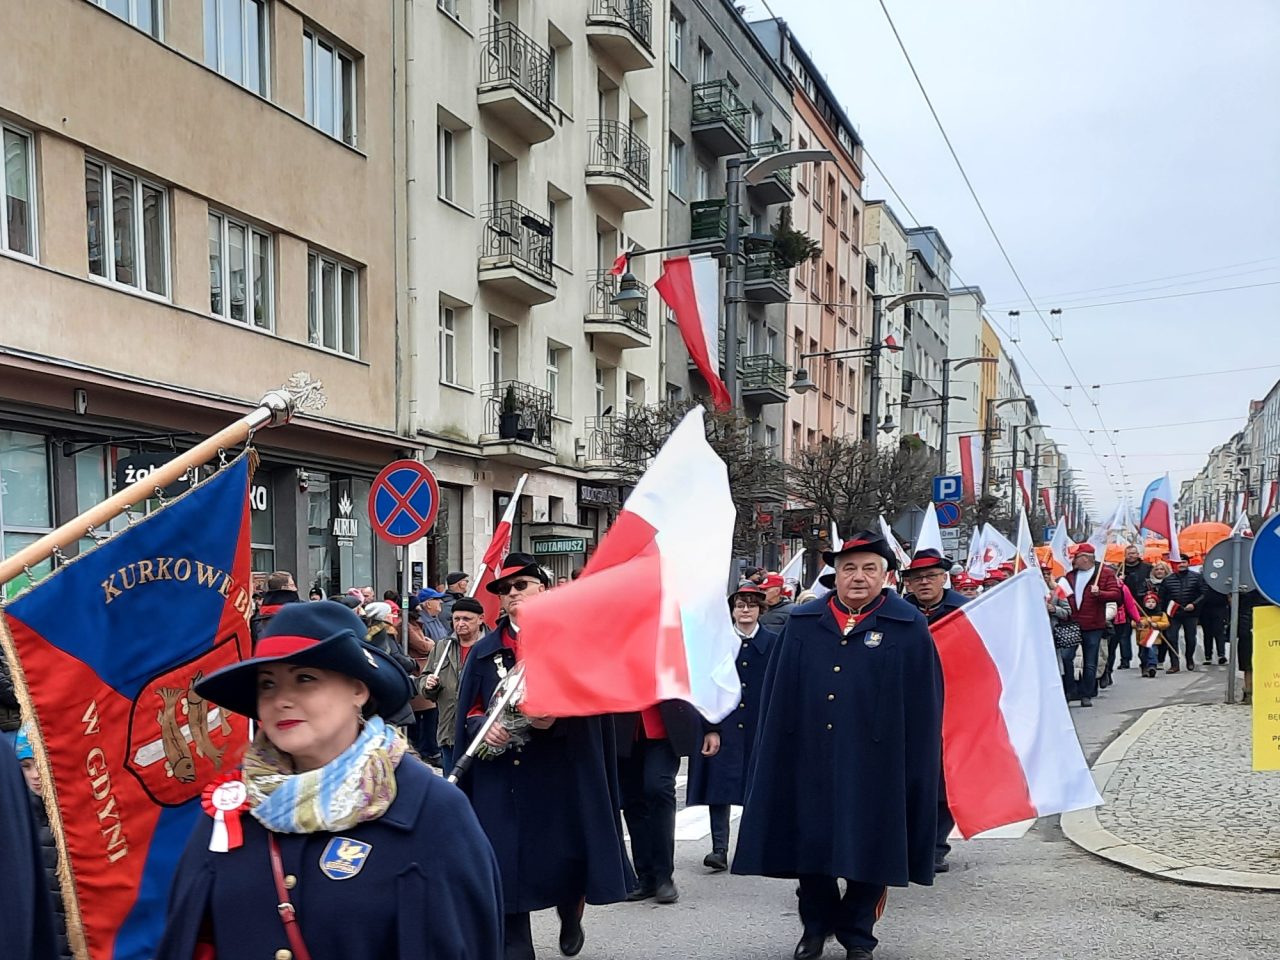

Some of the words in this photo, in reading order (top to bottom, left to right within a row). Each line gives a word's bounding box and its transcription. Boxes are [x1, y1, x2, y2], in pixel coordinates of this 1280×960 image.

[940, 479, 956, 499] P
[535, 540, 583, 552] NOTARIUSZ
[101, 557, 235, 605] KURKOWE
[86, 747, 129, 864] GDYNI
